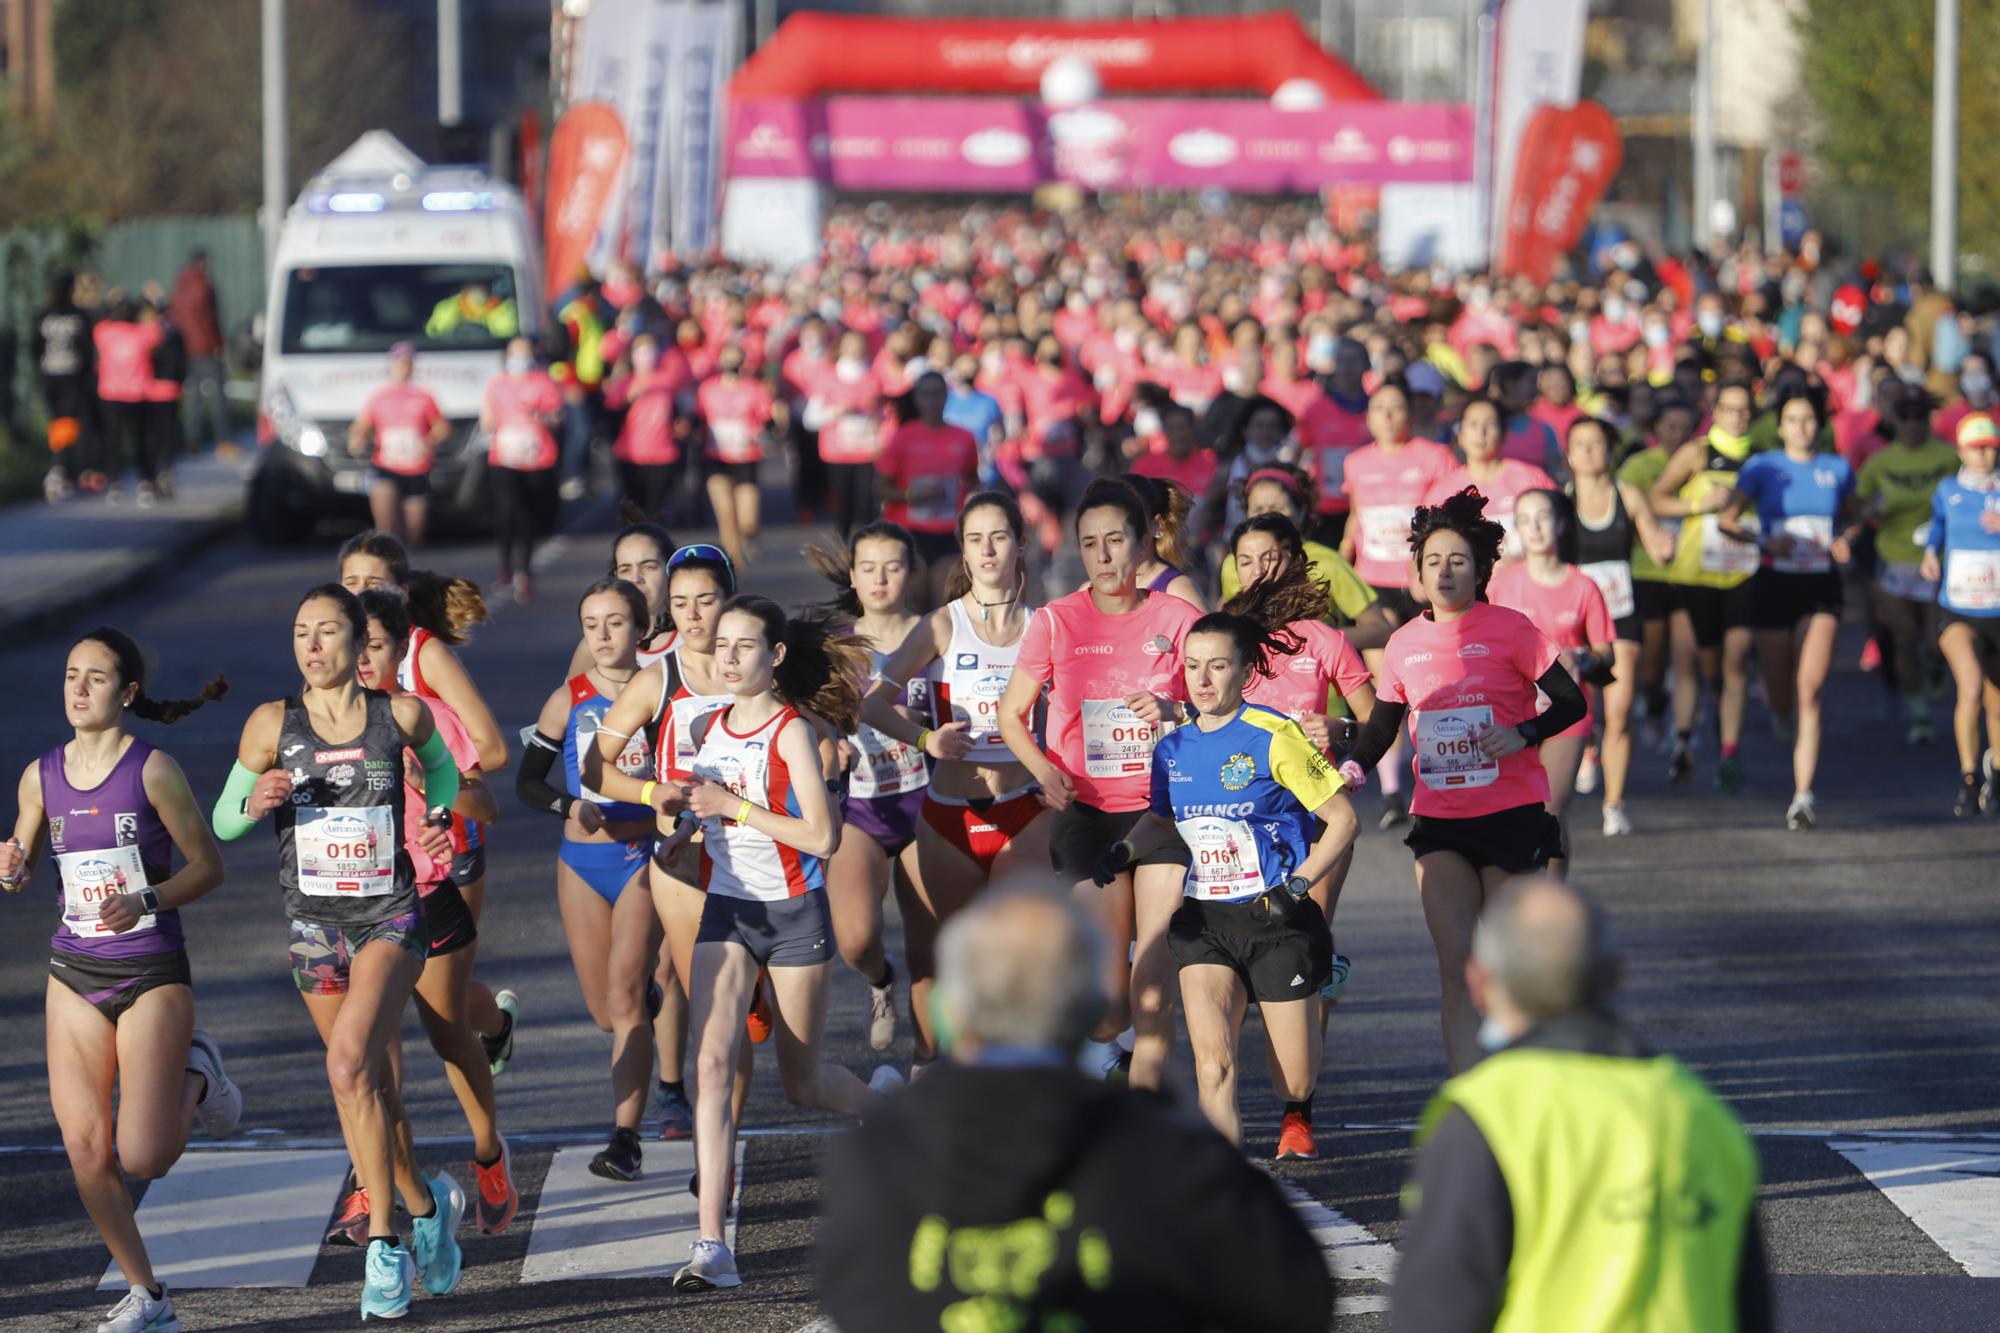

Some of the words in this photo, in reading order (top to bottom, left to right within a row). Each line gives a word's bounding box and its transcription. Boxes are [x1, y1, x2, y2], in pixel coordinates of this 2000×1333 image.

[1075, 645, 1113, 655] OYSHO
[1404, 652, 1433, 666] OYSHO
[1458, 693, 1485, 704] POR
[978, 701, 1000, 715] 01
[1112, 727, 1151, 742] 016
[1122, 745, 1141, 753] 2497
[1437, 740, 1470, 756] 016
[619, 753, 642, 767] 16
[1184, 802, 1255, 819] LUANCO
[327, 843, 367, 859] 016
[1200, 850, 1230, 865] 016
[1211, 867, 1224, 875] 667
[83, 883, 117, 902] 016
